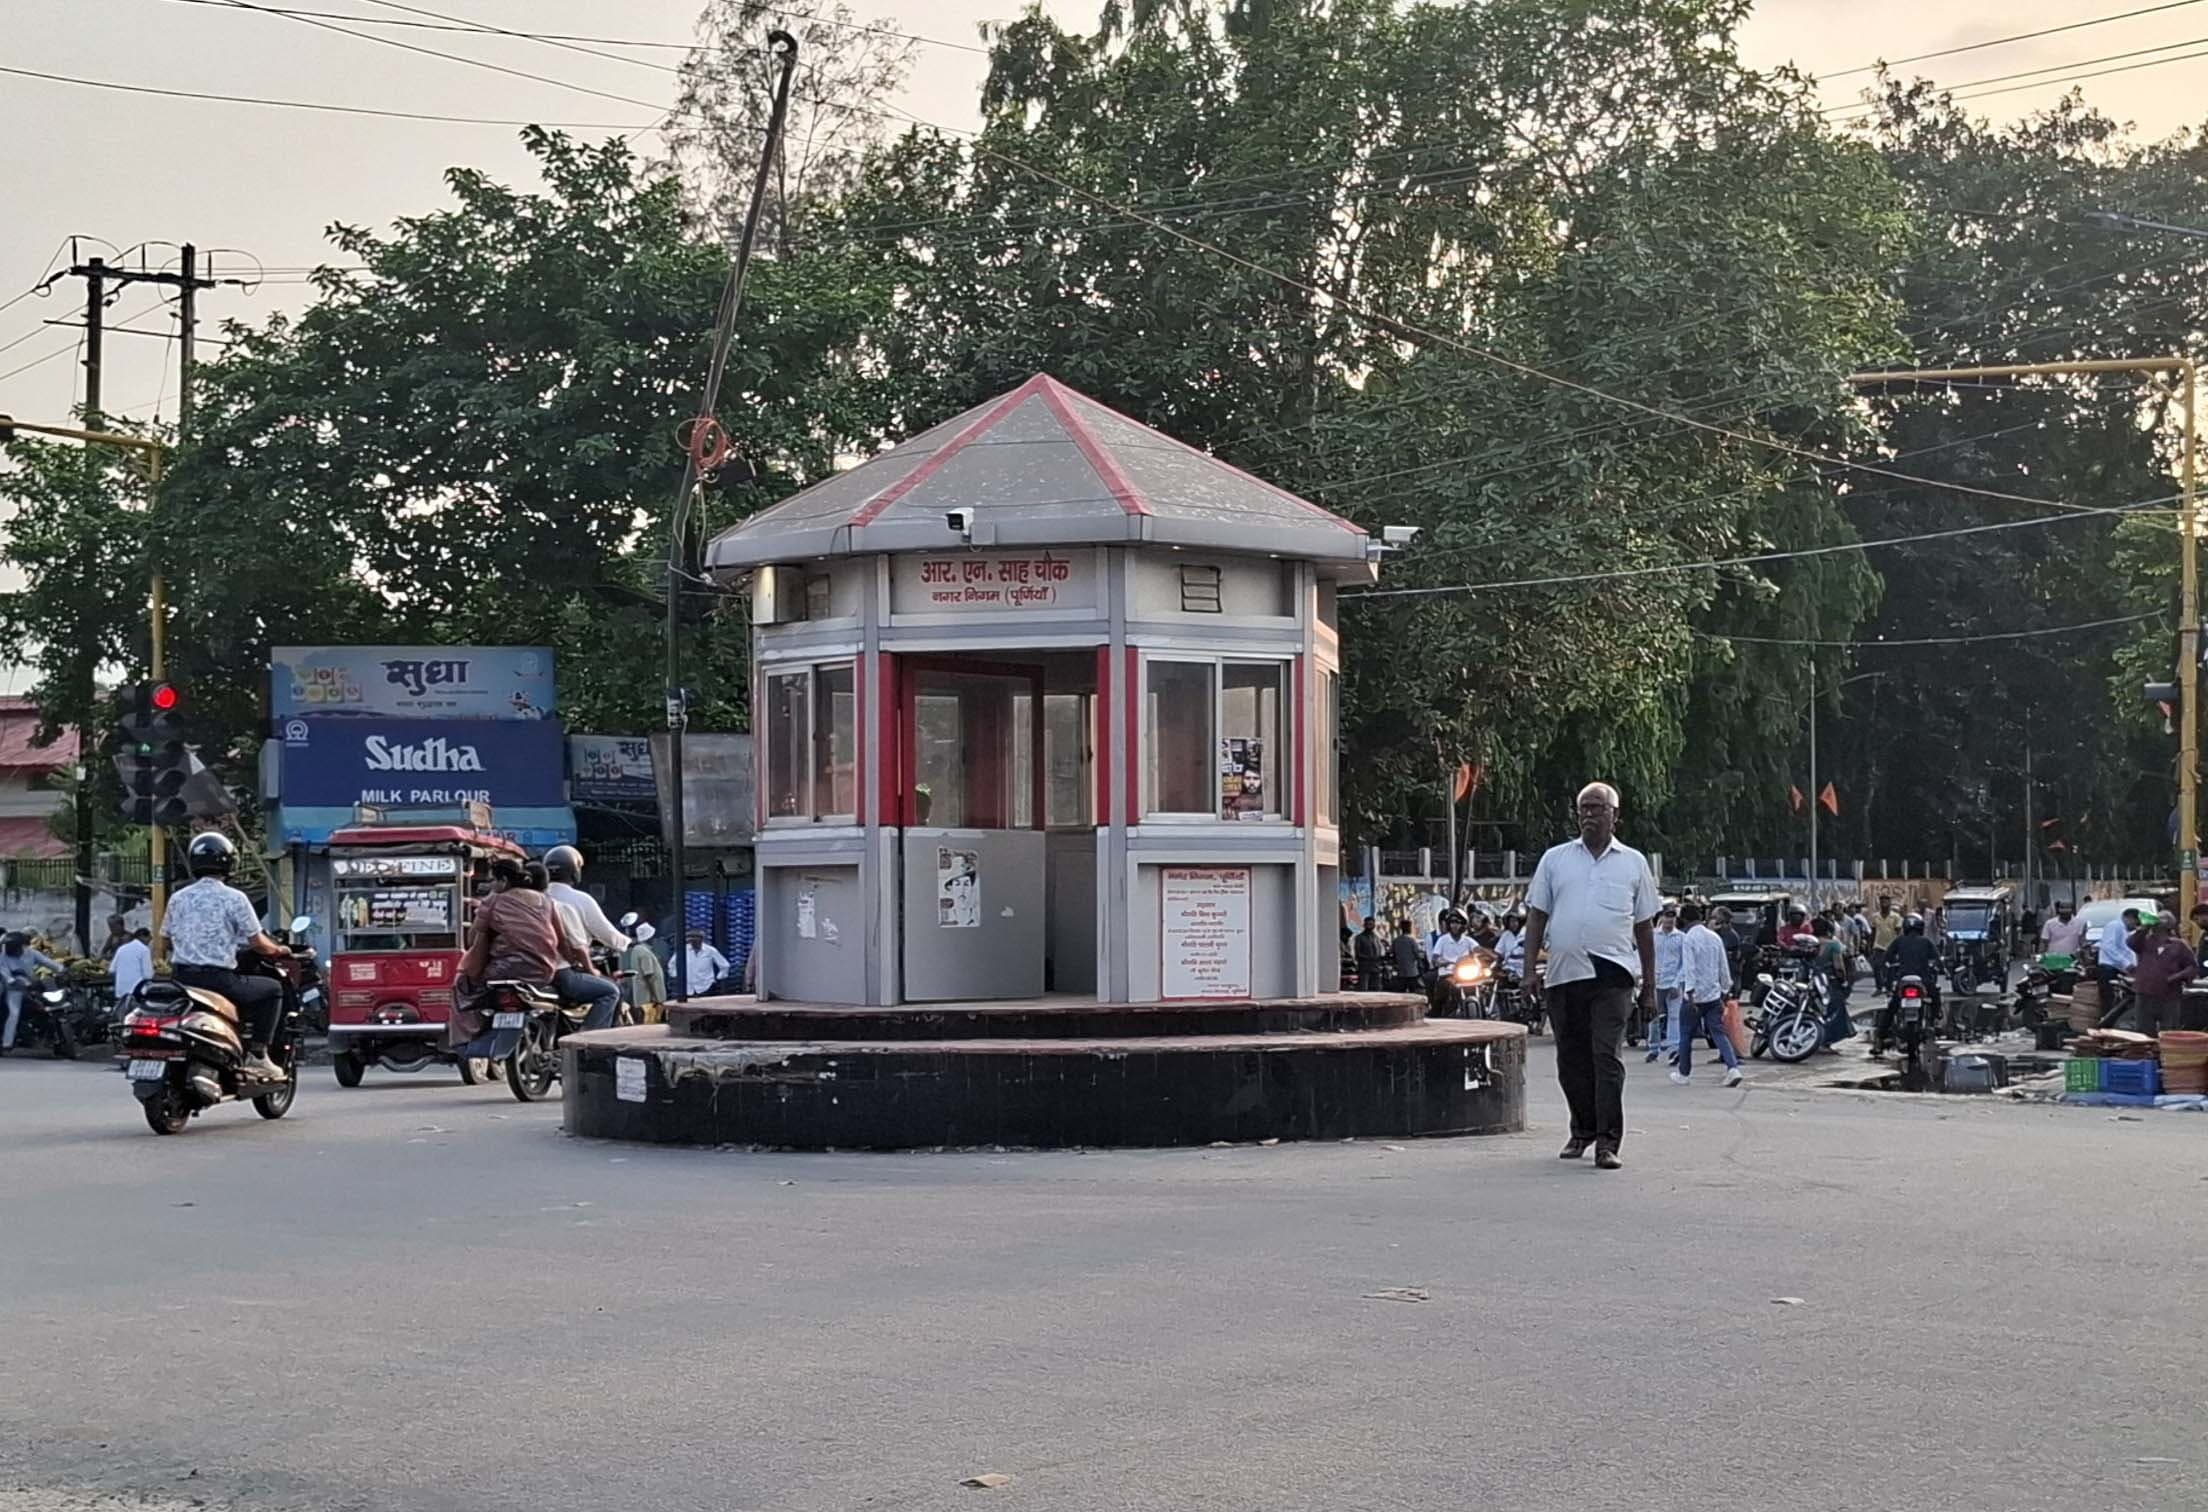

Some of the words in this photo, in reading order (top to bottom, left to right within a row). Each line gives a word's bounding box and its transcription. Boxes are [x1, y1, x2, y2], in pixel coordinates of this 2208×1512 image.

[921, 560, 956, 583] आर.
[963, 560, 992, 583] एन.
[998, 560, 1030, 583] साह
[1034, 552, 1070, 582] चौक
[932, 590, 961, 602] नगर
[964, 587, 1000, 602] निगम
[380, 660, 471, 696] सुधा
[365, 735, 486, 771] Sudha
[362, 790, 402, 803] MILK
[411, 790, 490, 803] PARLOUR
